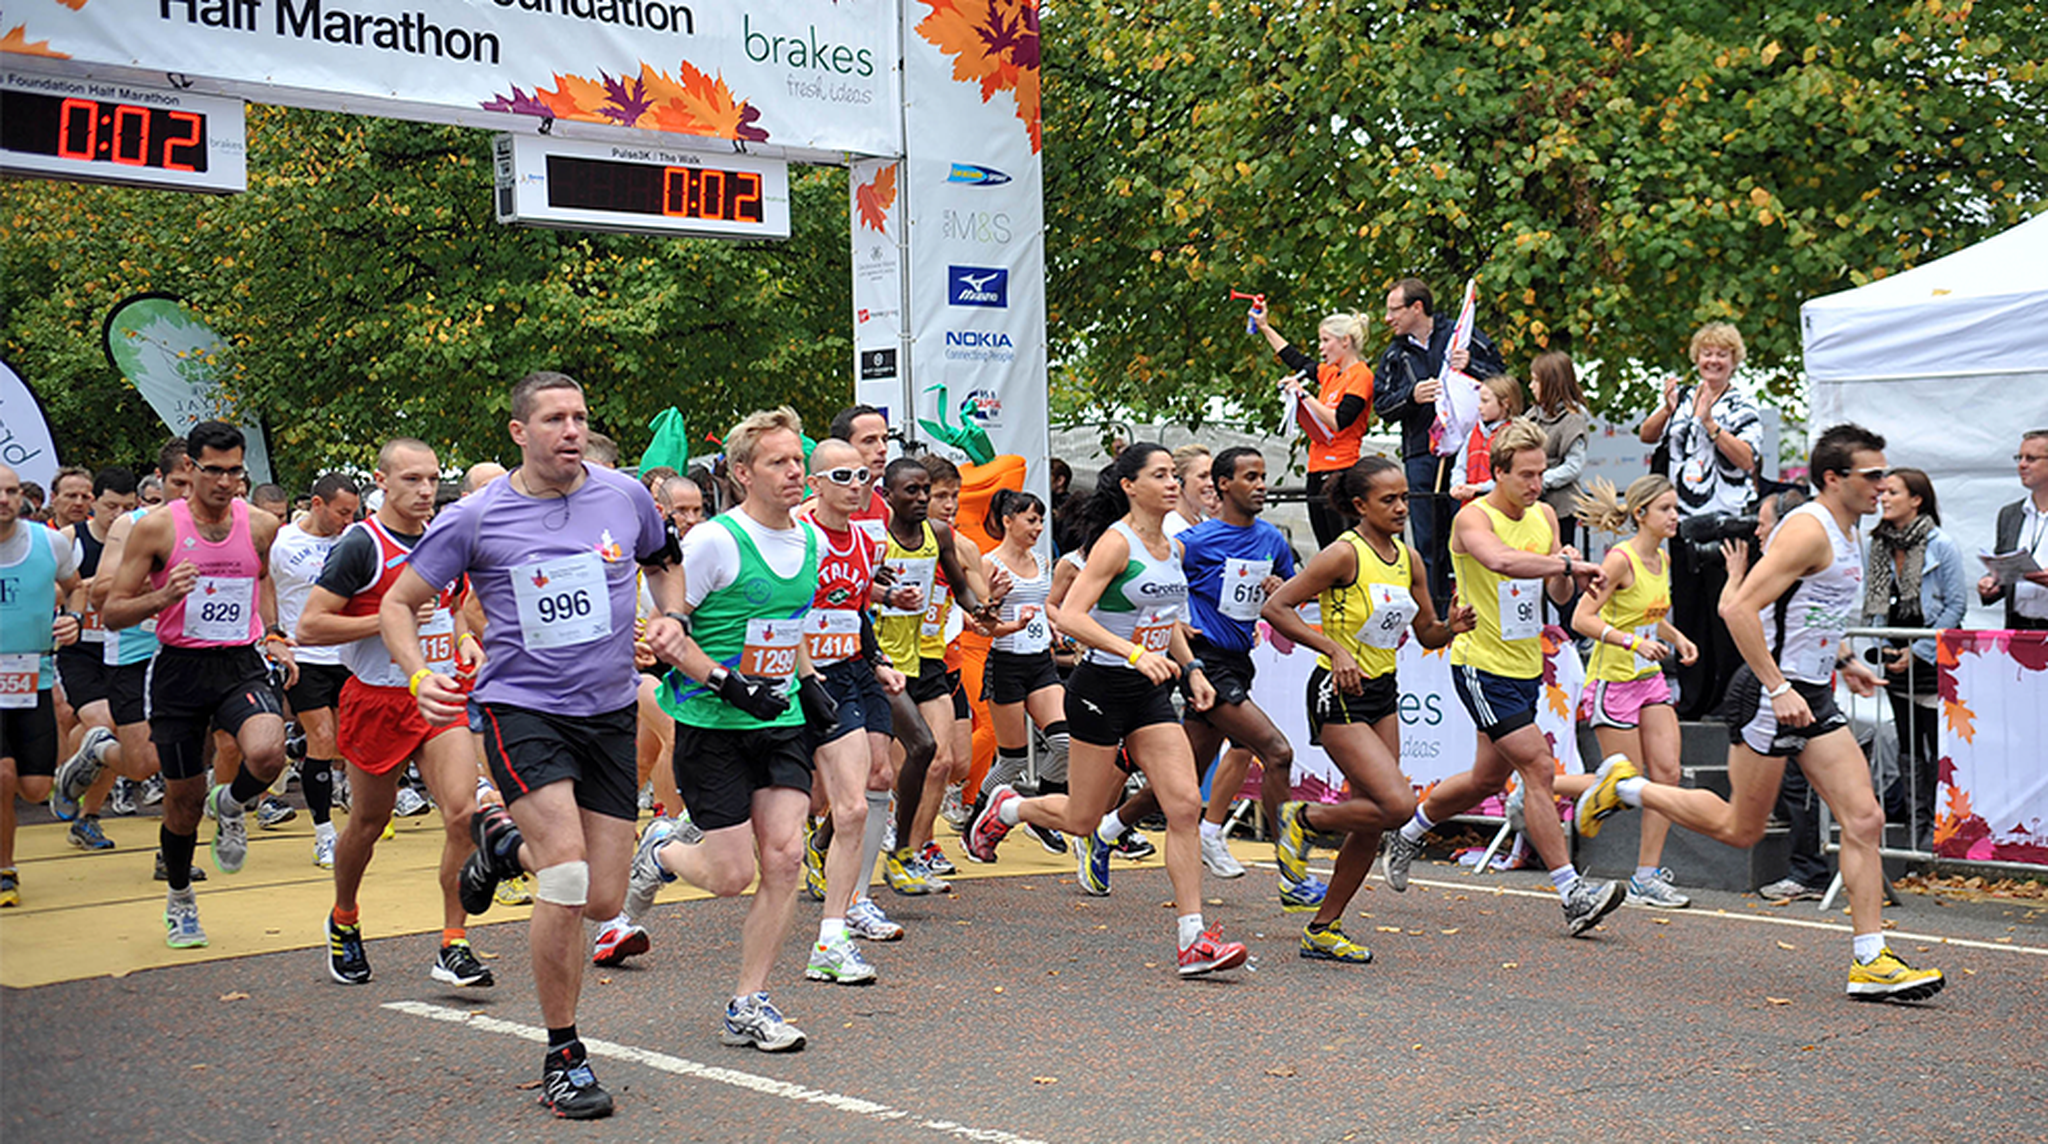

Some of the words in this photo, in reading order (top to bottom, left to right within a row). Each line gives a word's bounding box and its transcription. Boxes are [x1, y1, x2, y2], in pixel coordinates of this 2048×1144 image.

[276, 0, 500, 64] Marathon
[493, 0, 694, 34] dation
[744, 14, 873, 77] brakes
[8, 73, 85, 94] Foundation
[88, 84, 116, 98] Half
[119, 88, 180, 106] Marathon
[787, 73, 827, 101] fresh
[829, 82, 873, 104] ideas
[58, 97, 201, 172] 0:02
[662, 165, 761, 223] 0:02
[951, 210, 1012, 244] M&S
[946, 331, 1013, 348] NOKIA
[538, 589, 591, 623] 996
[1234, 583, 1261, 603] 615
[201, 602, 240, 622] 829
[811, 635, 855, 657] 1414
[1028, 622, 1044, 639] 99
